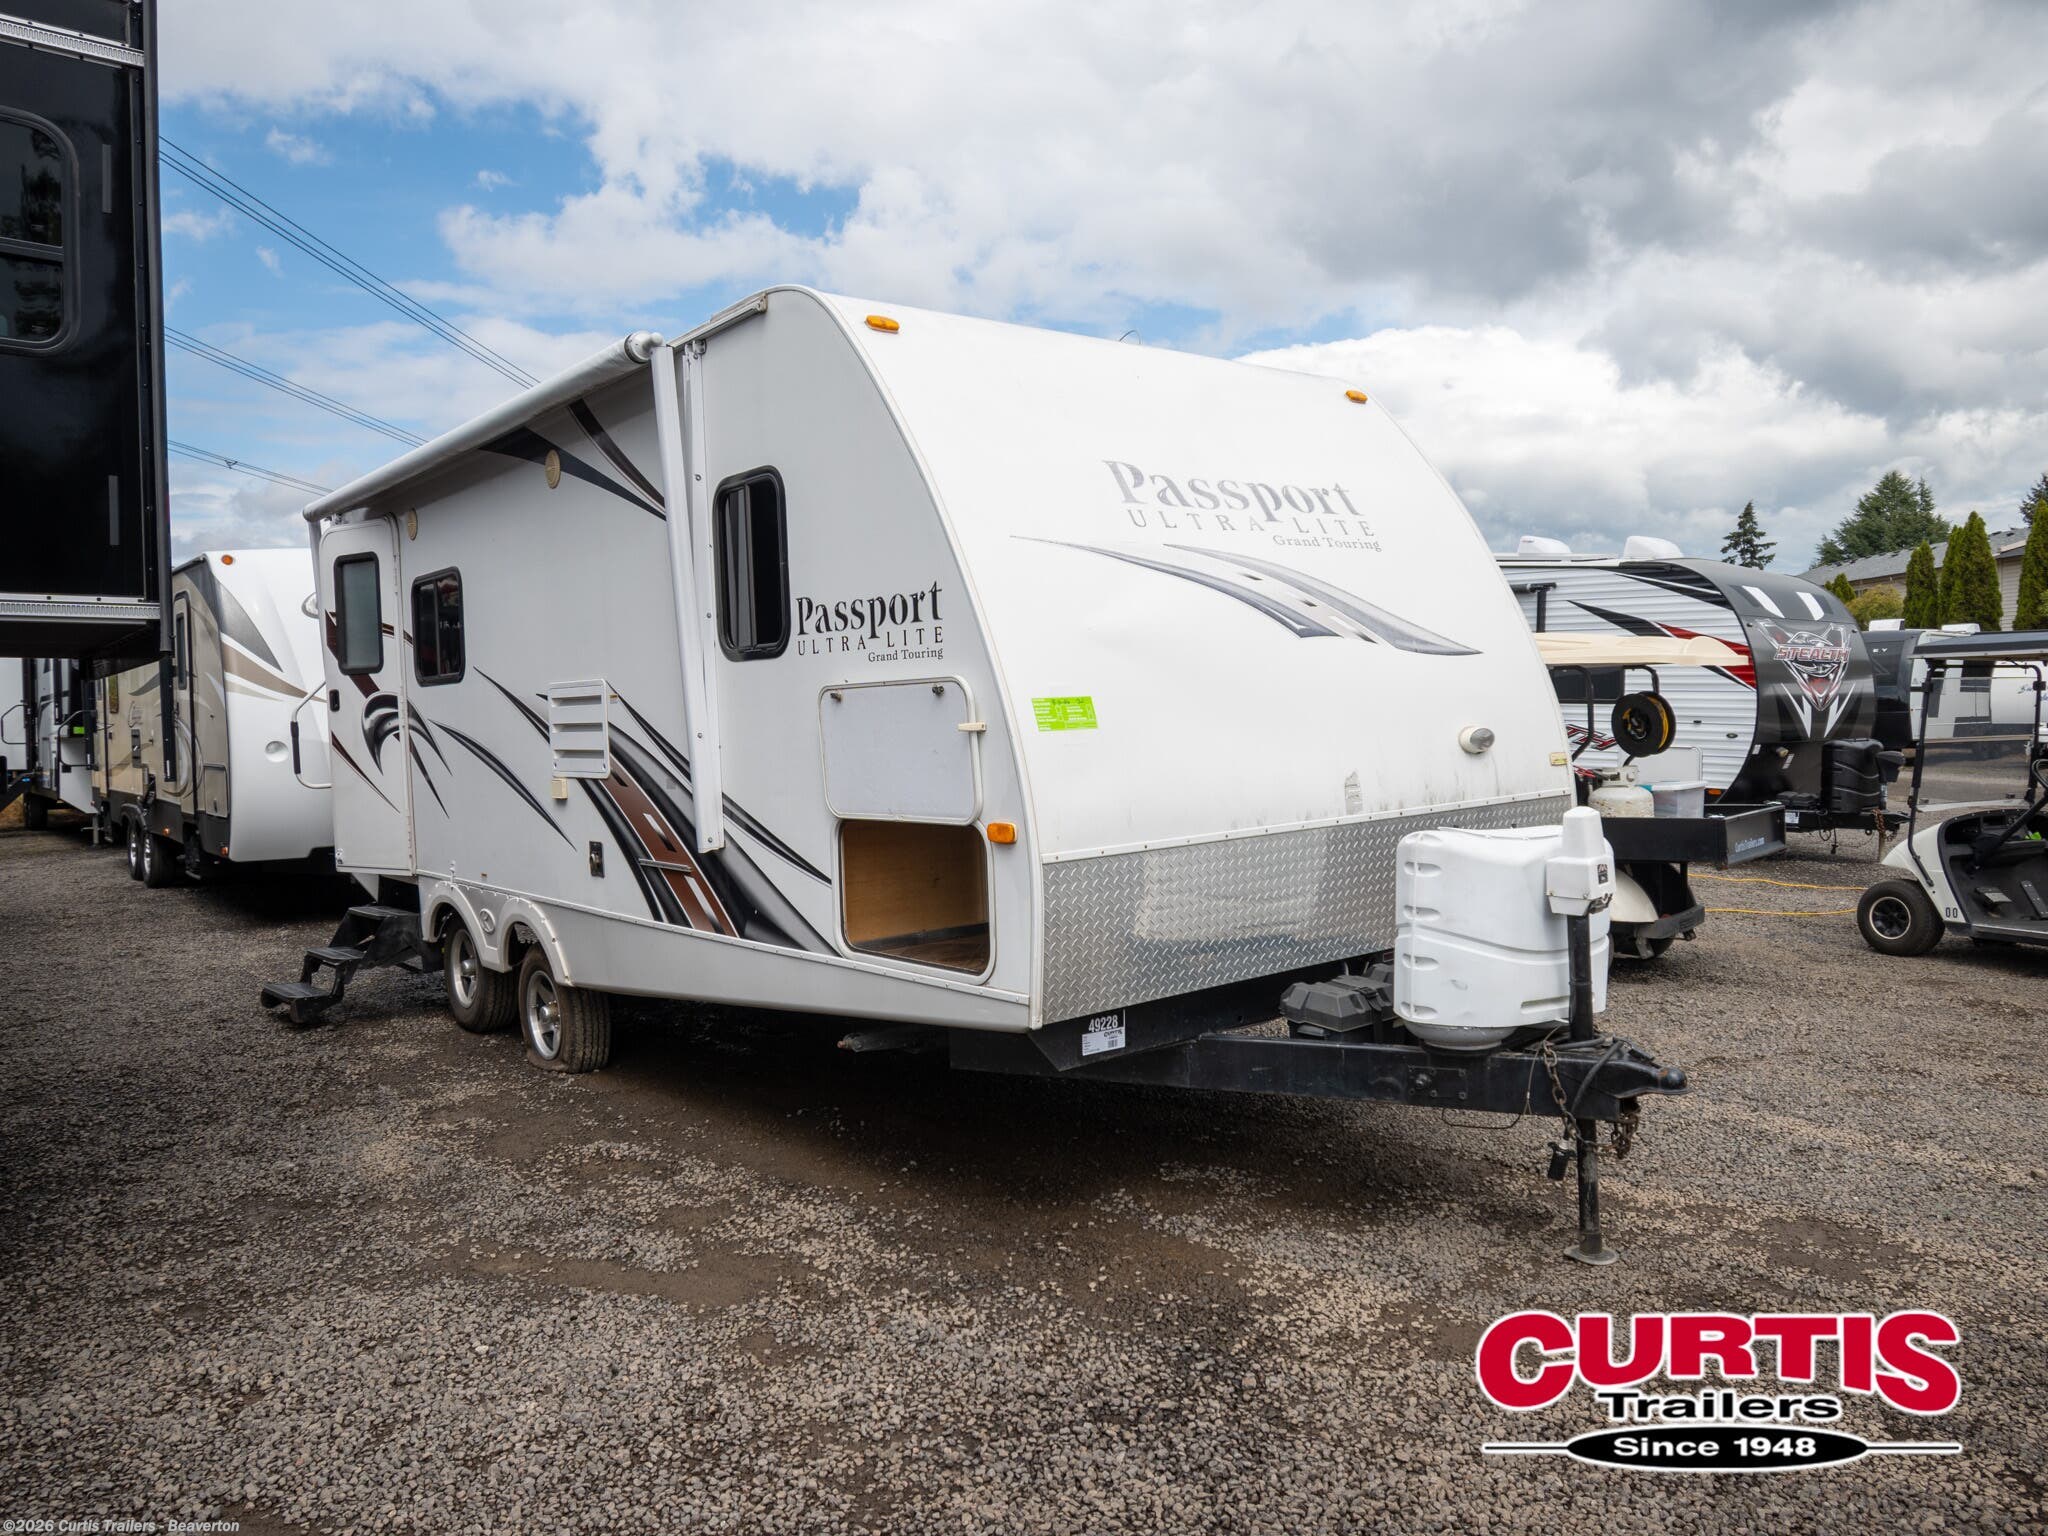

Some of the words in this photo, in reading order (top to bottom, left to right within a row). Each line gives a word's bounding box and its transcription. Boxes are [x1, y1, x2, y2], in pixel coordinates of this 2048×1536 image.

[1102, 459, 1365, 523] Passport
[1127, 508, 1266, 533] ULTRA
[1292, 517, 1375, 537] LITE
[1272, 534, 1321, 549] Grand
[1322, 537, 1383, 552] Touring
[796, 580, 943, 639] Passport
[798, 634, 867, 656] ULTRA
[886, 626, 943, 648] LITE
[868, 650, 898, 662] Grand
[901, 648, 944, 660] Touring
[1774, 646, 1851, 662] STEALTH
[1088, 1015, 1118, 1033] 49228
